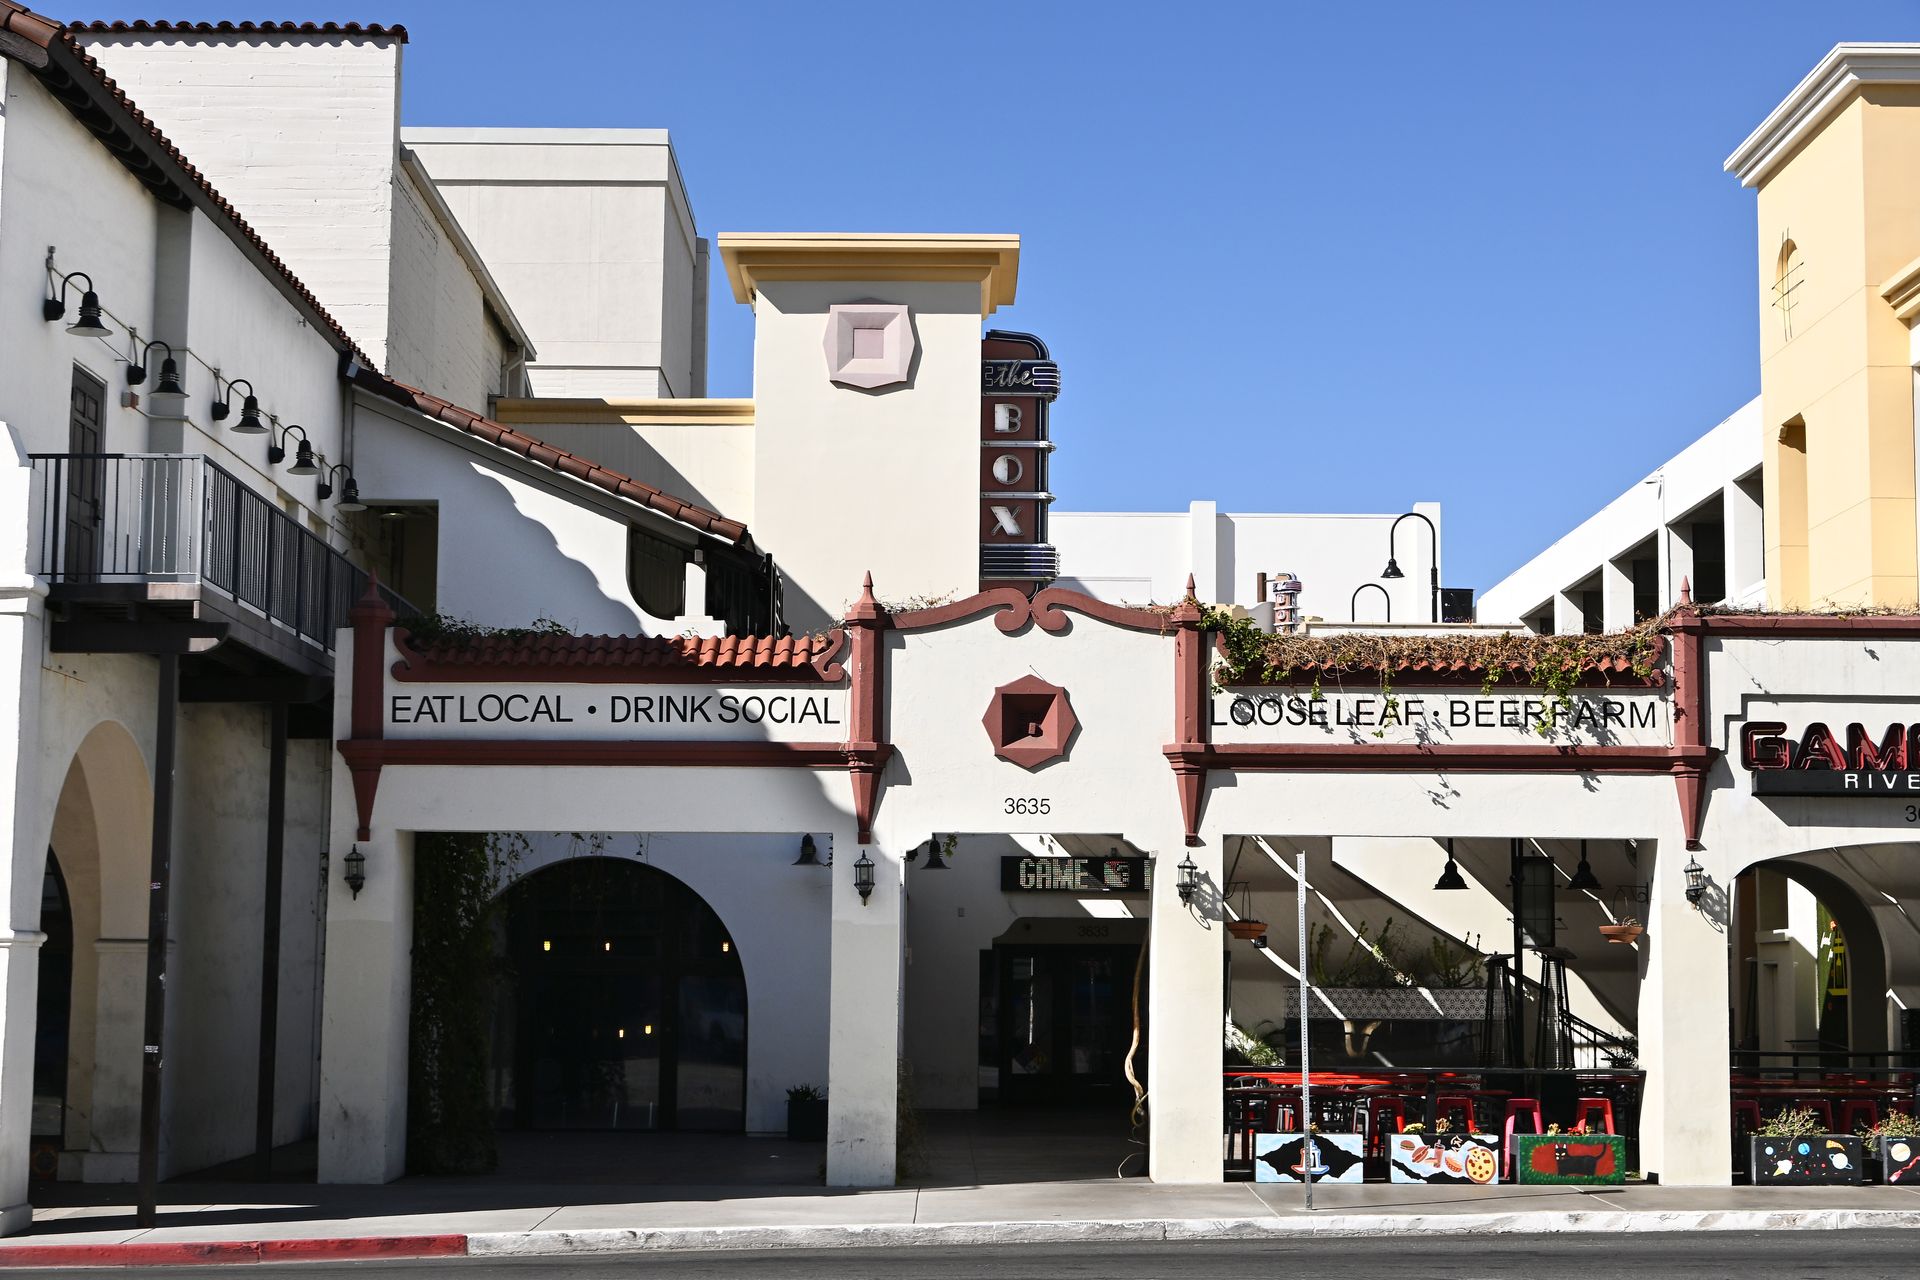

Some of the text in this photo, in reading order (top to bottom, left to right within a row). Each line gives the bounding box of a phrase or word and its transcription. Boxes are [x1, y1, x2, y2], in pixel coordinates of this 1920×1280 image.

[994, 359, 1033, 387] the
[991, 403, 1024, 536] BOX
[1004, 797, 1051, 815] 3635
[1905, 804, 1920, 823] 3
[1019, 858, 1088, 888] GAME
